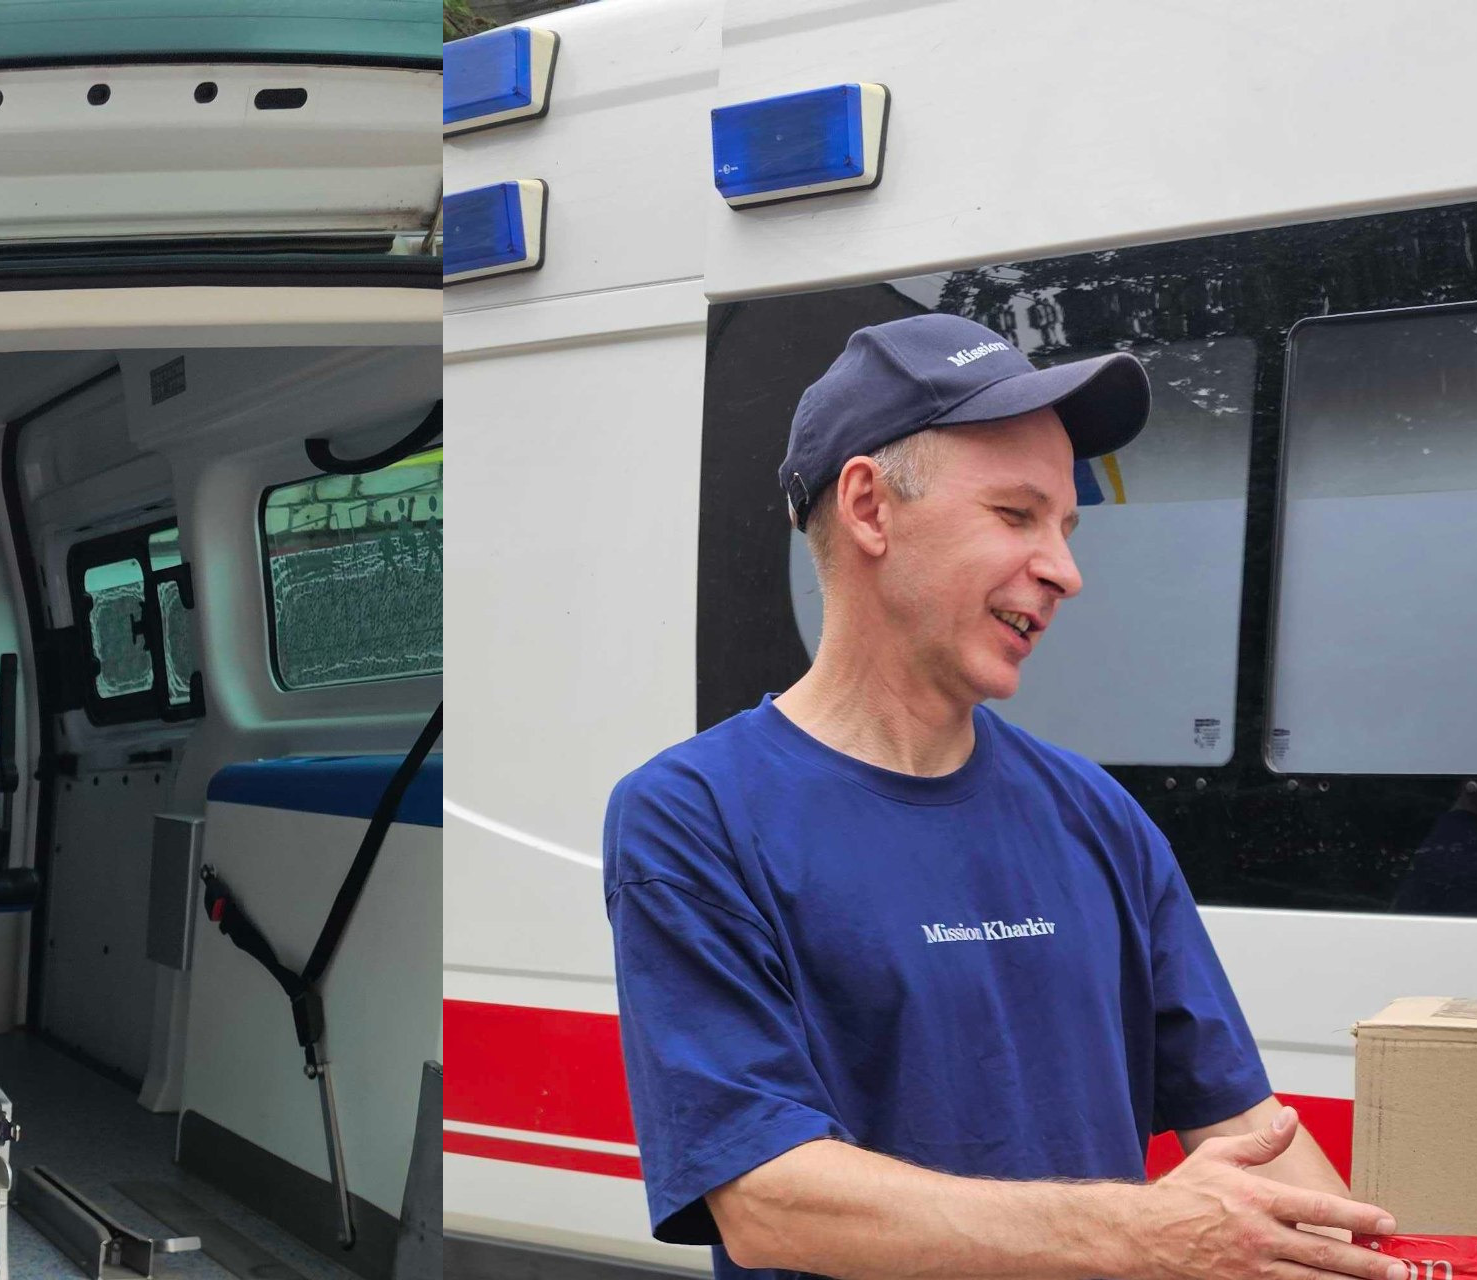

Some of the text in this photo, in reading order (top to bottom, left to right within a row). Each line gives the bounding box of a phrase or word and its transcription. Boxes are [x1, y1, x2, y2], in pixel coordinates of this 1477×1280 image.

[947, 341, 1009, 367] Mission
[921, 917, 1055, 943] Mission Kharkiv
